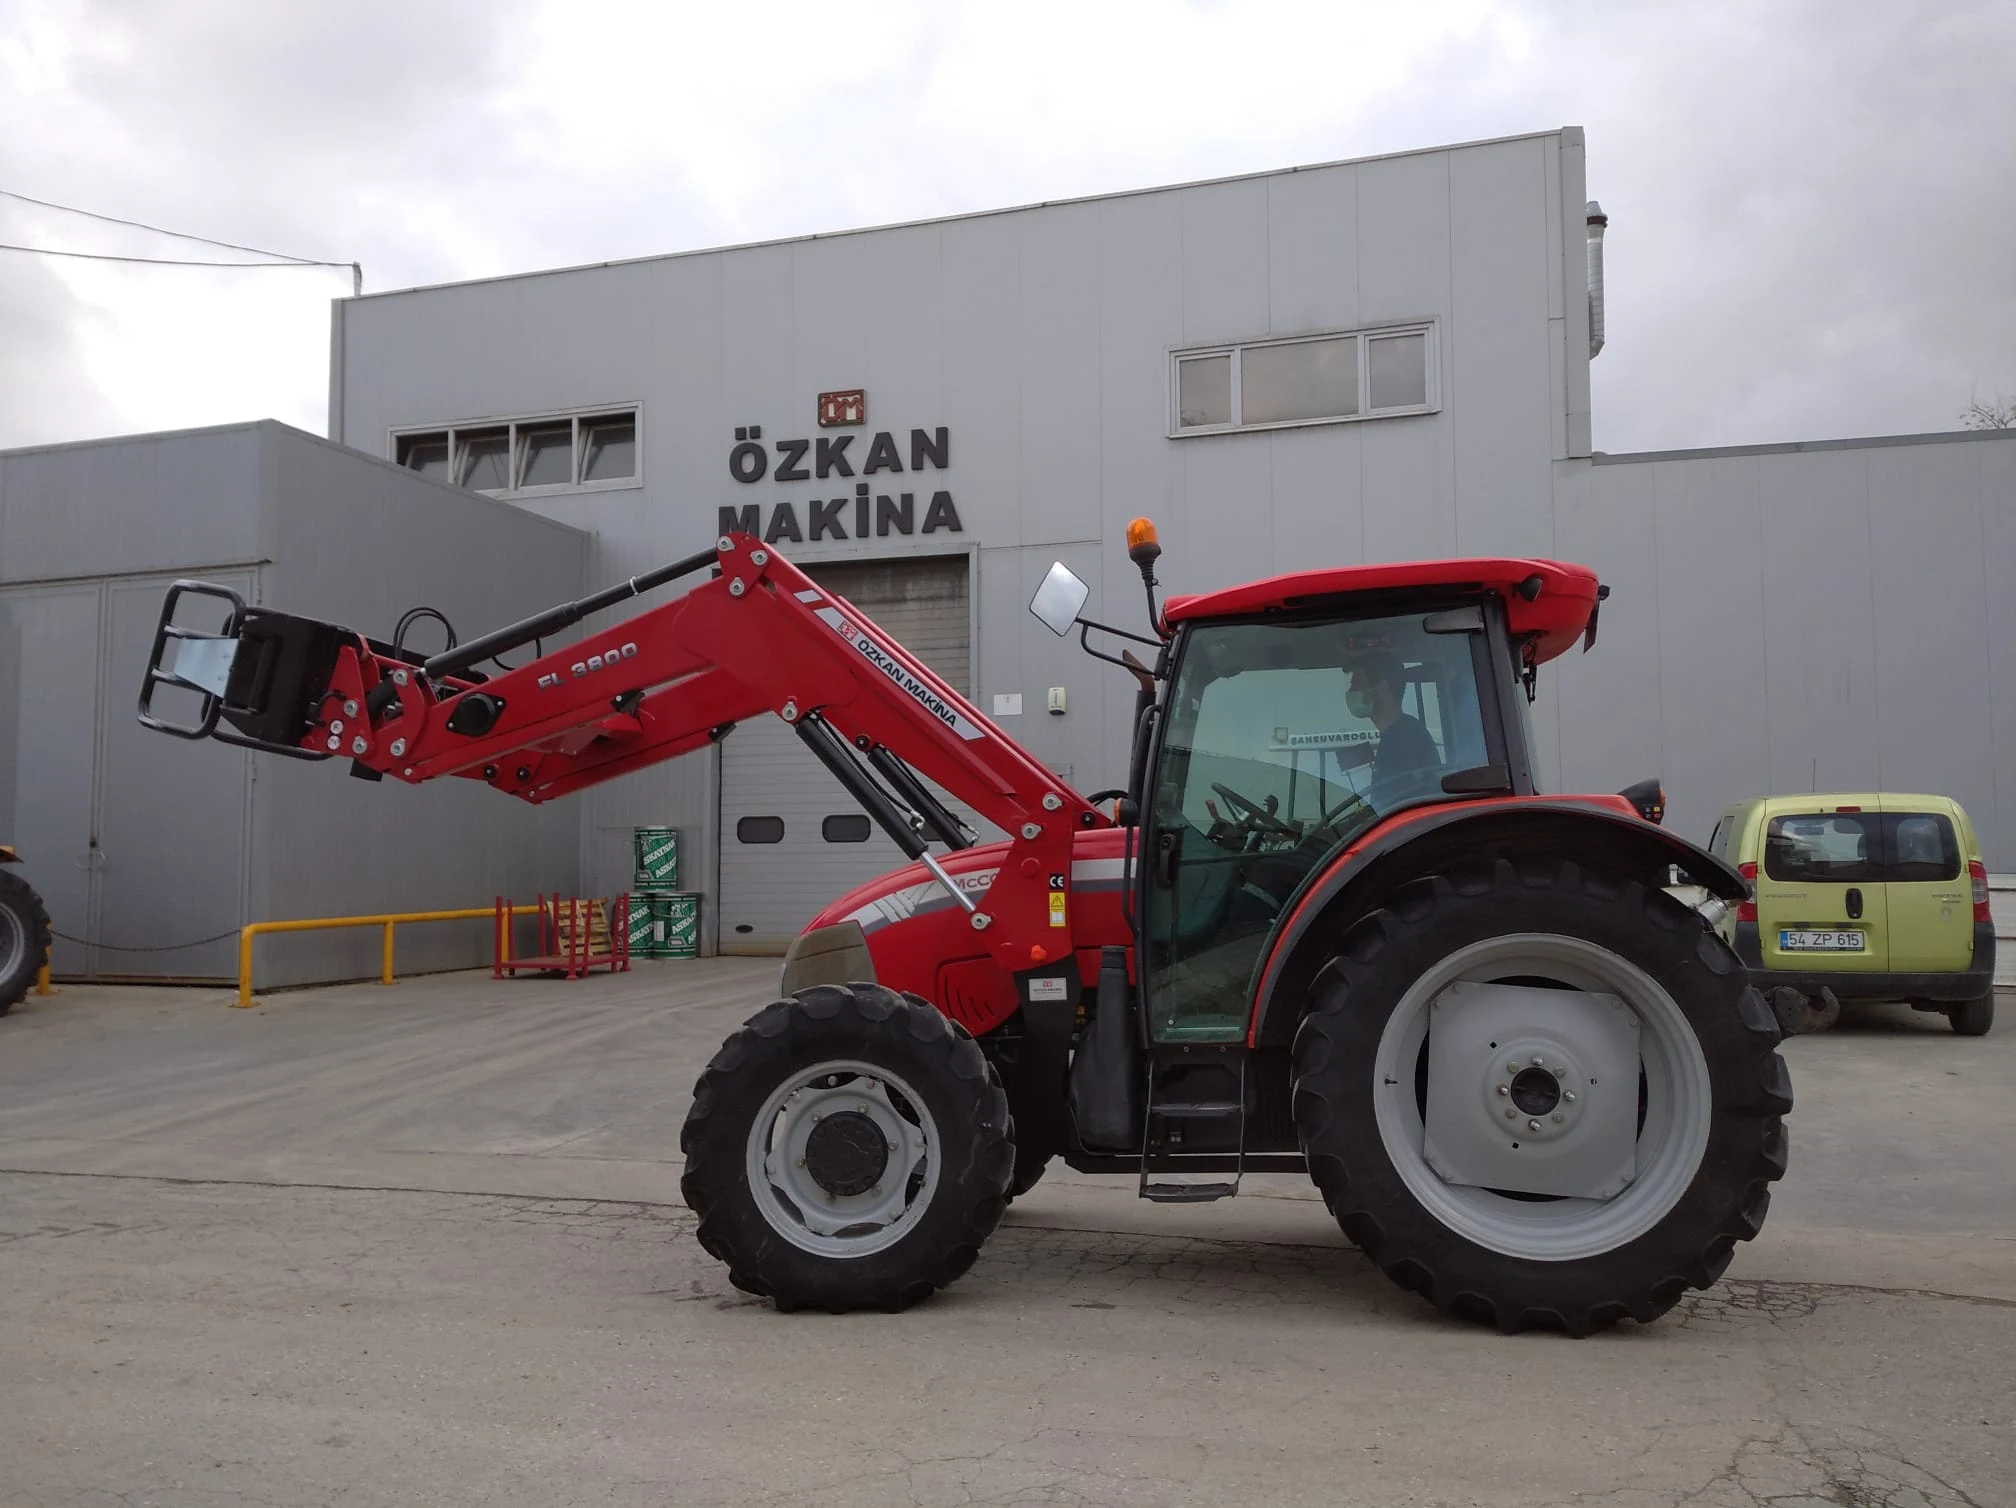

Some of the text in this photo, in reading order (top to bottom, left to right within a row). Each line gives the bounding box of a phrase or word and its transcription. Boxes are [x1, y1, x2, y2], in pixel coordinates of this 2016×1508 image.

[729, 425, 949, 483] ÖZKAN
[718, 483, 962, 543] MAKİNA
[537, 673, 566, 691] FL
[857, 638, 957, 728] ÖZKAN MAKİNA
[1049, 876, 1064, 887] CE
[1789, 933, 1859, 946] 54 ZP 615
